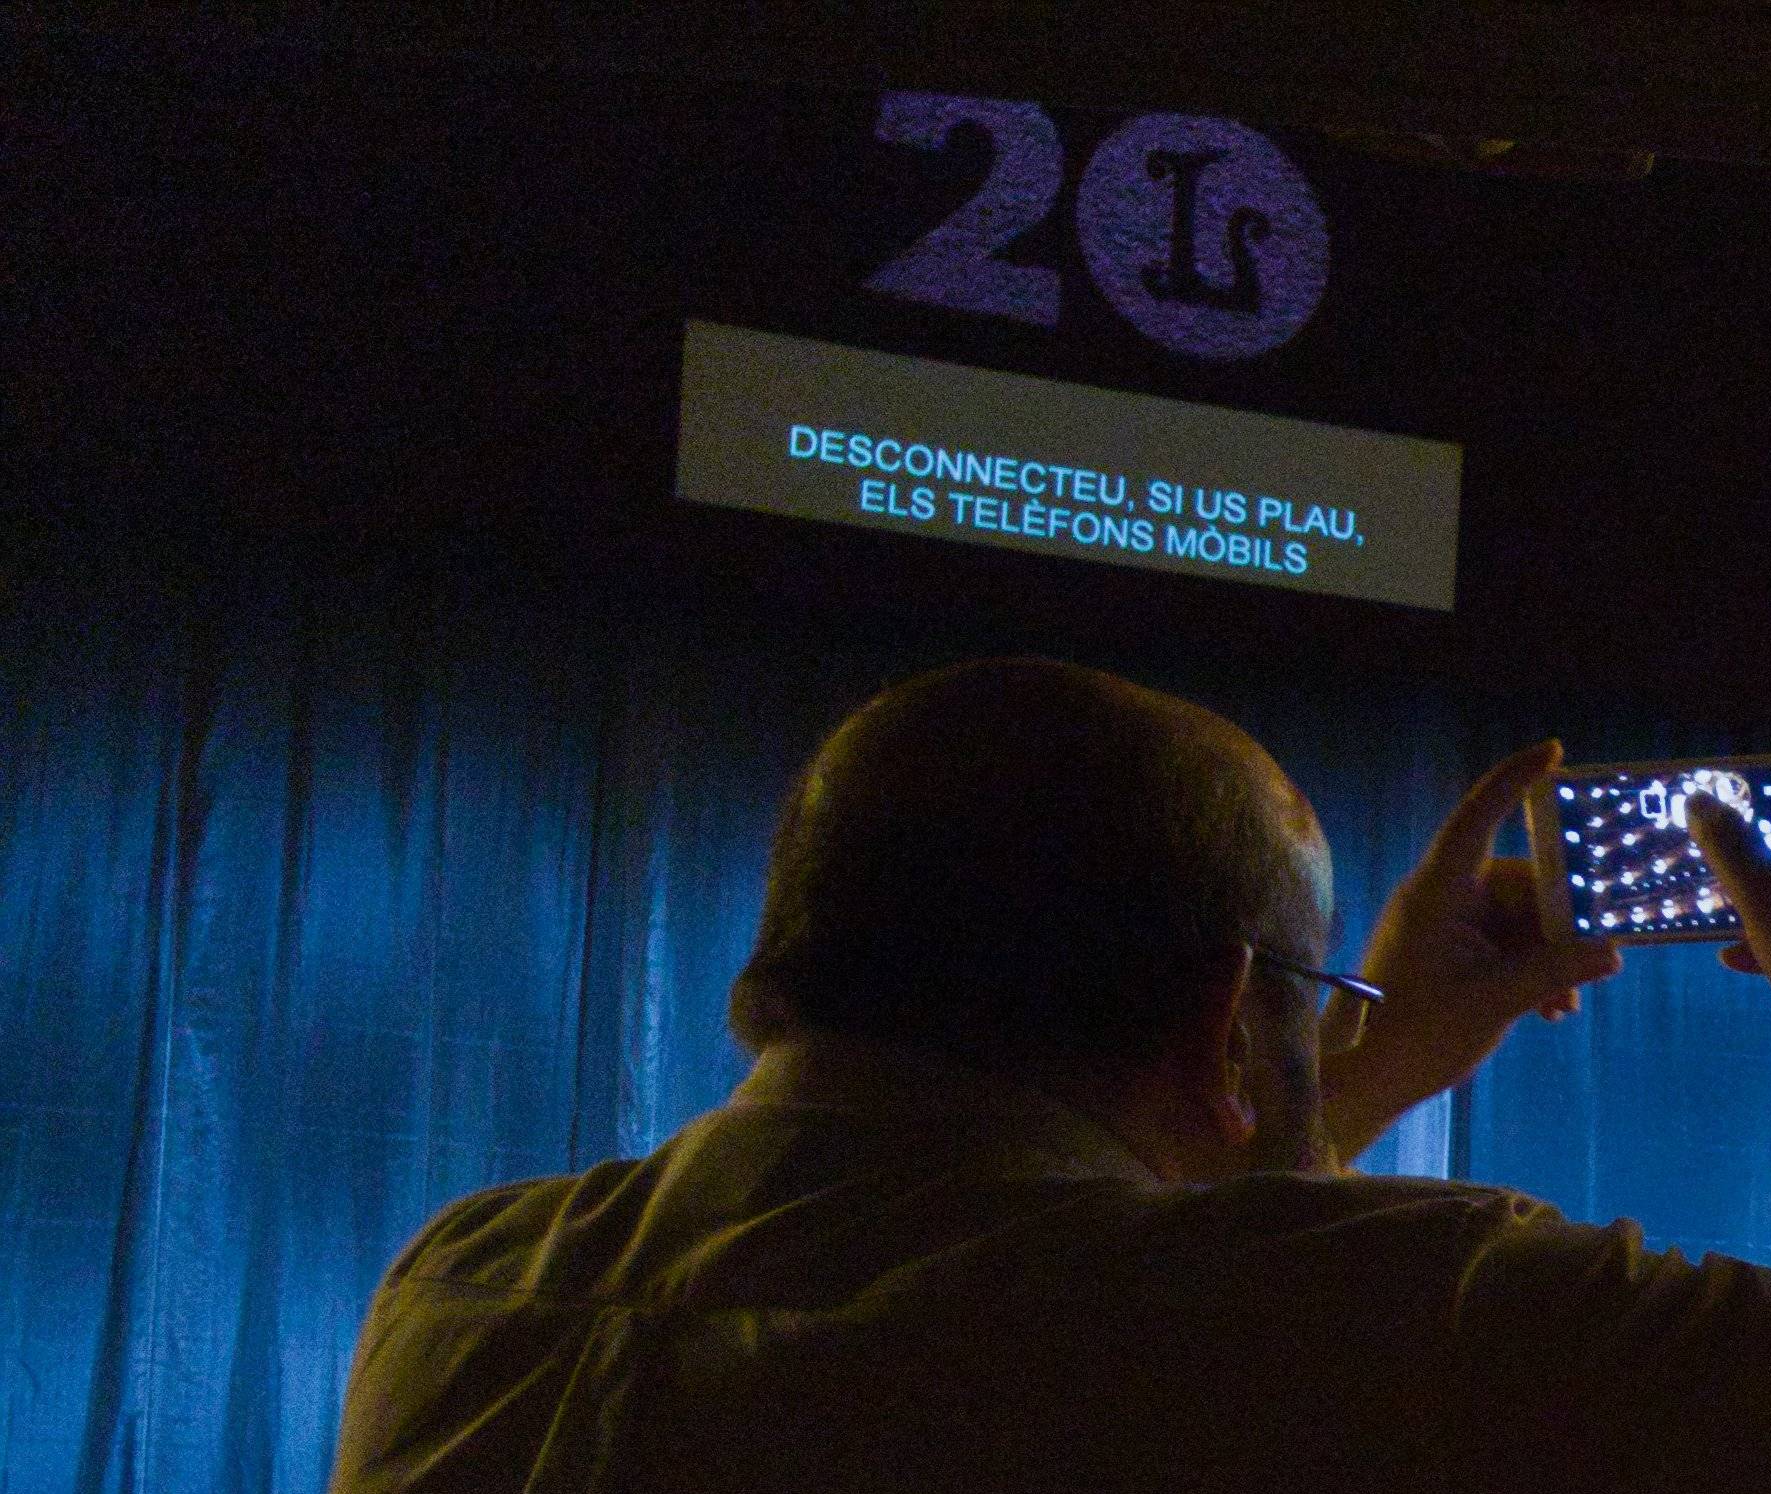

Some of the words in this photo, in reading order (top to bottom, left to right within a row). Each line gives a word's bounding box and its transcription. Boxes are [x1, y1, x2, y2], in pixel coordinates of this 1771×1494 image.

[788, 424, 1135, 513] DESCONNECTEU,
[1147, 479, 1185, 515] SI
[1194, 488, 1248, 526] US
[1256, 496, 1366, 547] PLAU,
[859, 478, 937, 521] ELS
[948, 490, 1156, 553] TELÈFONS
[1163, 523, 1309, 576] MÒBILS
